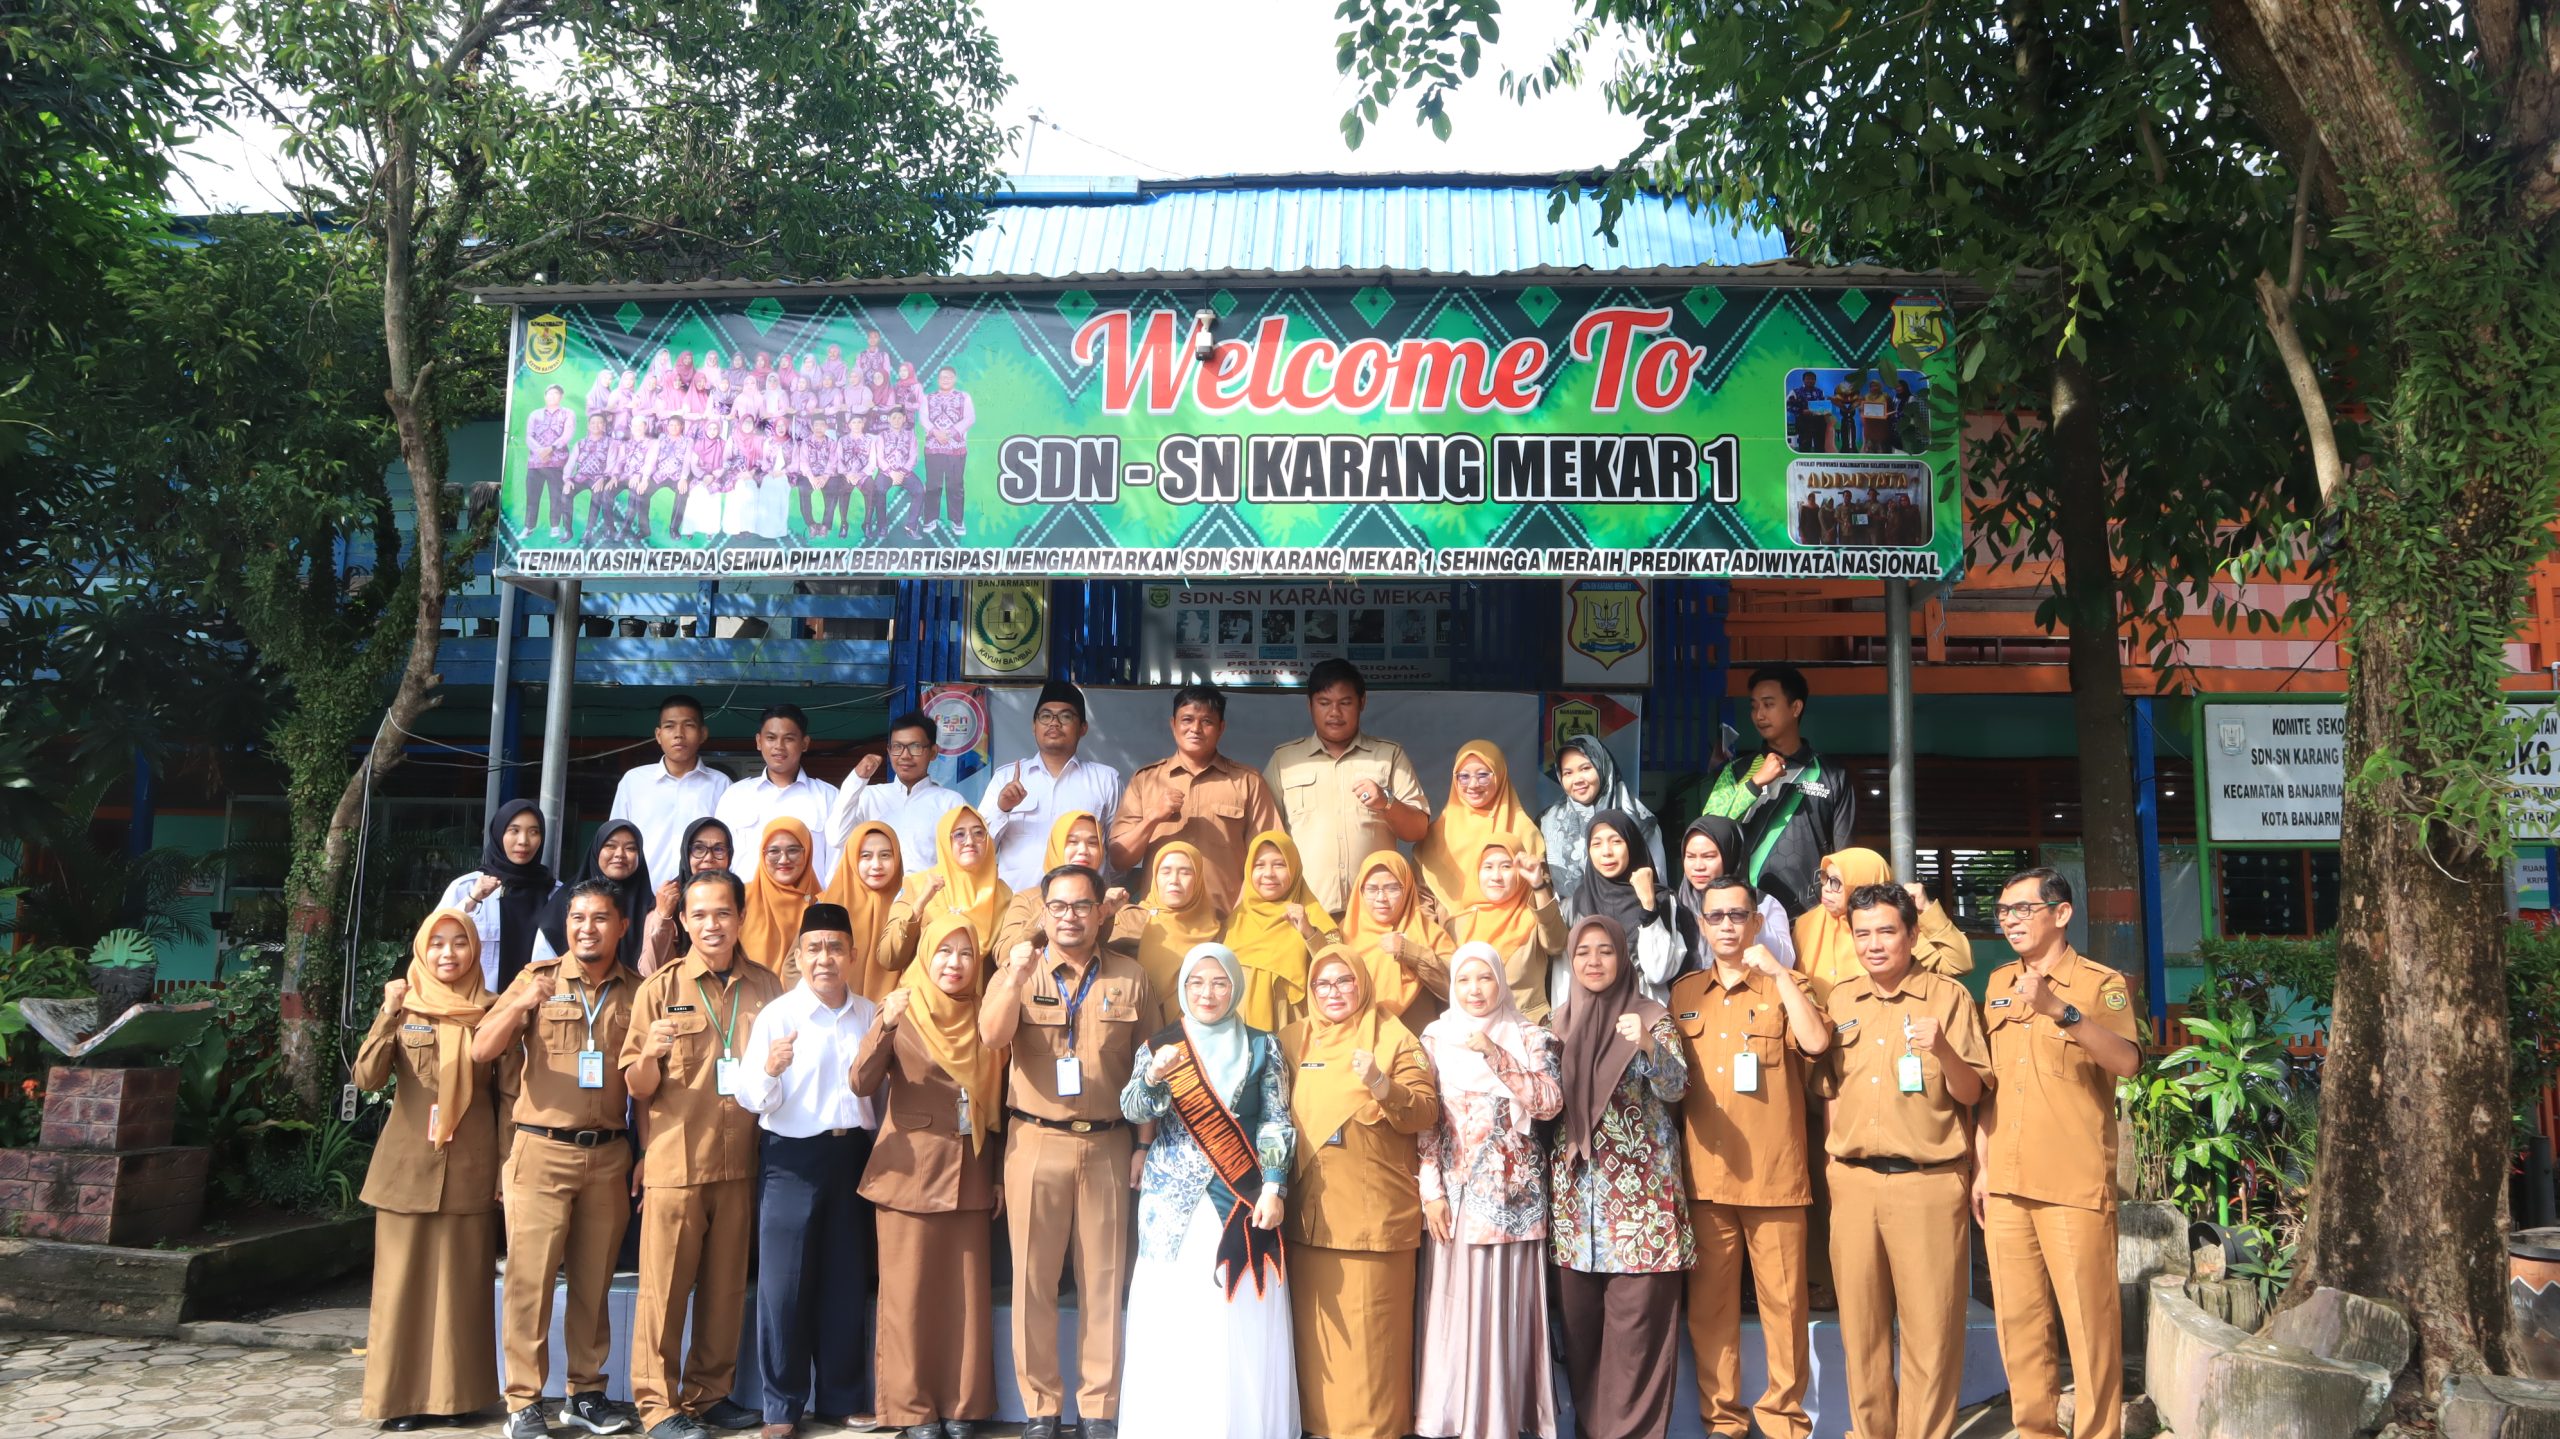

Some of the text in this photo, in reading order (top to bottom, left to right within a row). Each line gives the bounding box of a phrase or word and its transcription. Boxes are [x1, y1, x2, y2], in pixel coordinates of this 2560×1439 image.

[1071, 307, 1707, 413] Welcome To
[1000, 437, 1118, 502] SDN
[1160, 437, 1240, 502] SN
[1249, 437, 1485, 501] KARANG
[1493, 436, 1699, 501] MEKAR
[1703, 436, 1738, 501] 1
[1807, 472, 1908, 488] ADIWIYATA
[519, 550, 1940, 576] TERIMA KASIH KEPADA SEMUA PIHAK BERPARTISIPASI MENGHANTARKAN SDN SN KARANG MEKAR 1 SEHINGGA MERAIH PREDIKAT ADIWIYATA NASIONAL
[977, 579, 1039, 587] BANJARMASIN
[1179, 587, 1451, 606] SDN-SN KARANG MEKAR
[978, 647, 1002, 664] KAYUH
[1227, 660, 1304, 668] PRESTASI
[1228, 669, 1275, 677] TAHUN
[2272, 717, 2345, 735] KOMITE SEKO
[2251, 748, 2339, 765] SDN-SN KARANG
[2223, 784, 2343, 798] KECAMATAN BANJARMA
[2261, 811, 2340, 826] KOTA BANJARM
[1166, 1063, 1200, 1099] PAUD
[1178, 1085, 1215, 1124] KOTA
[1193, 1110, 1254, 1184] BANJARMASIN
